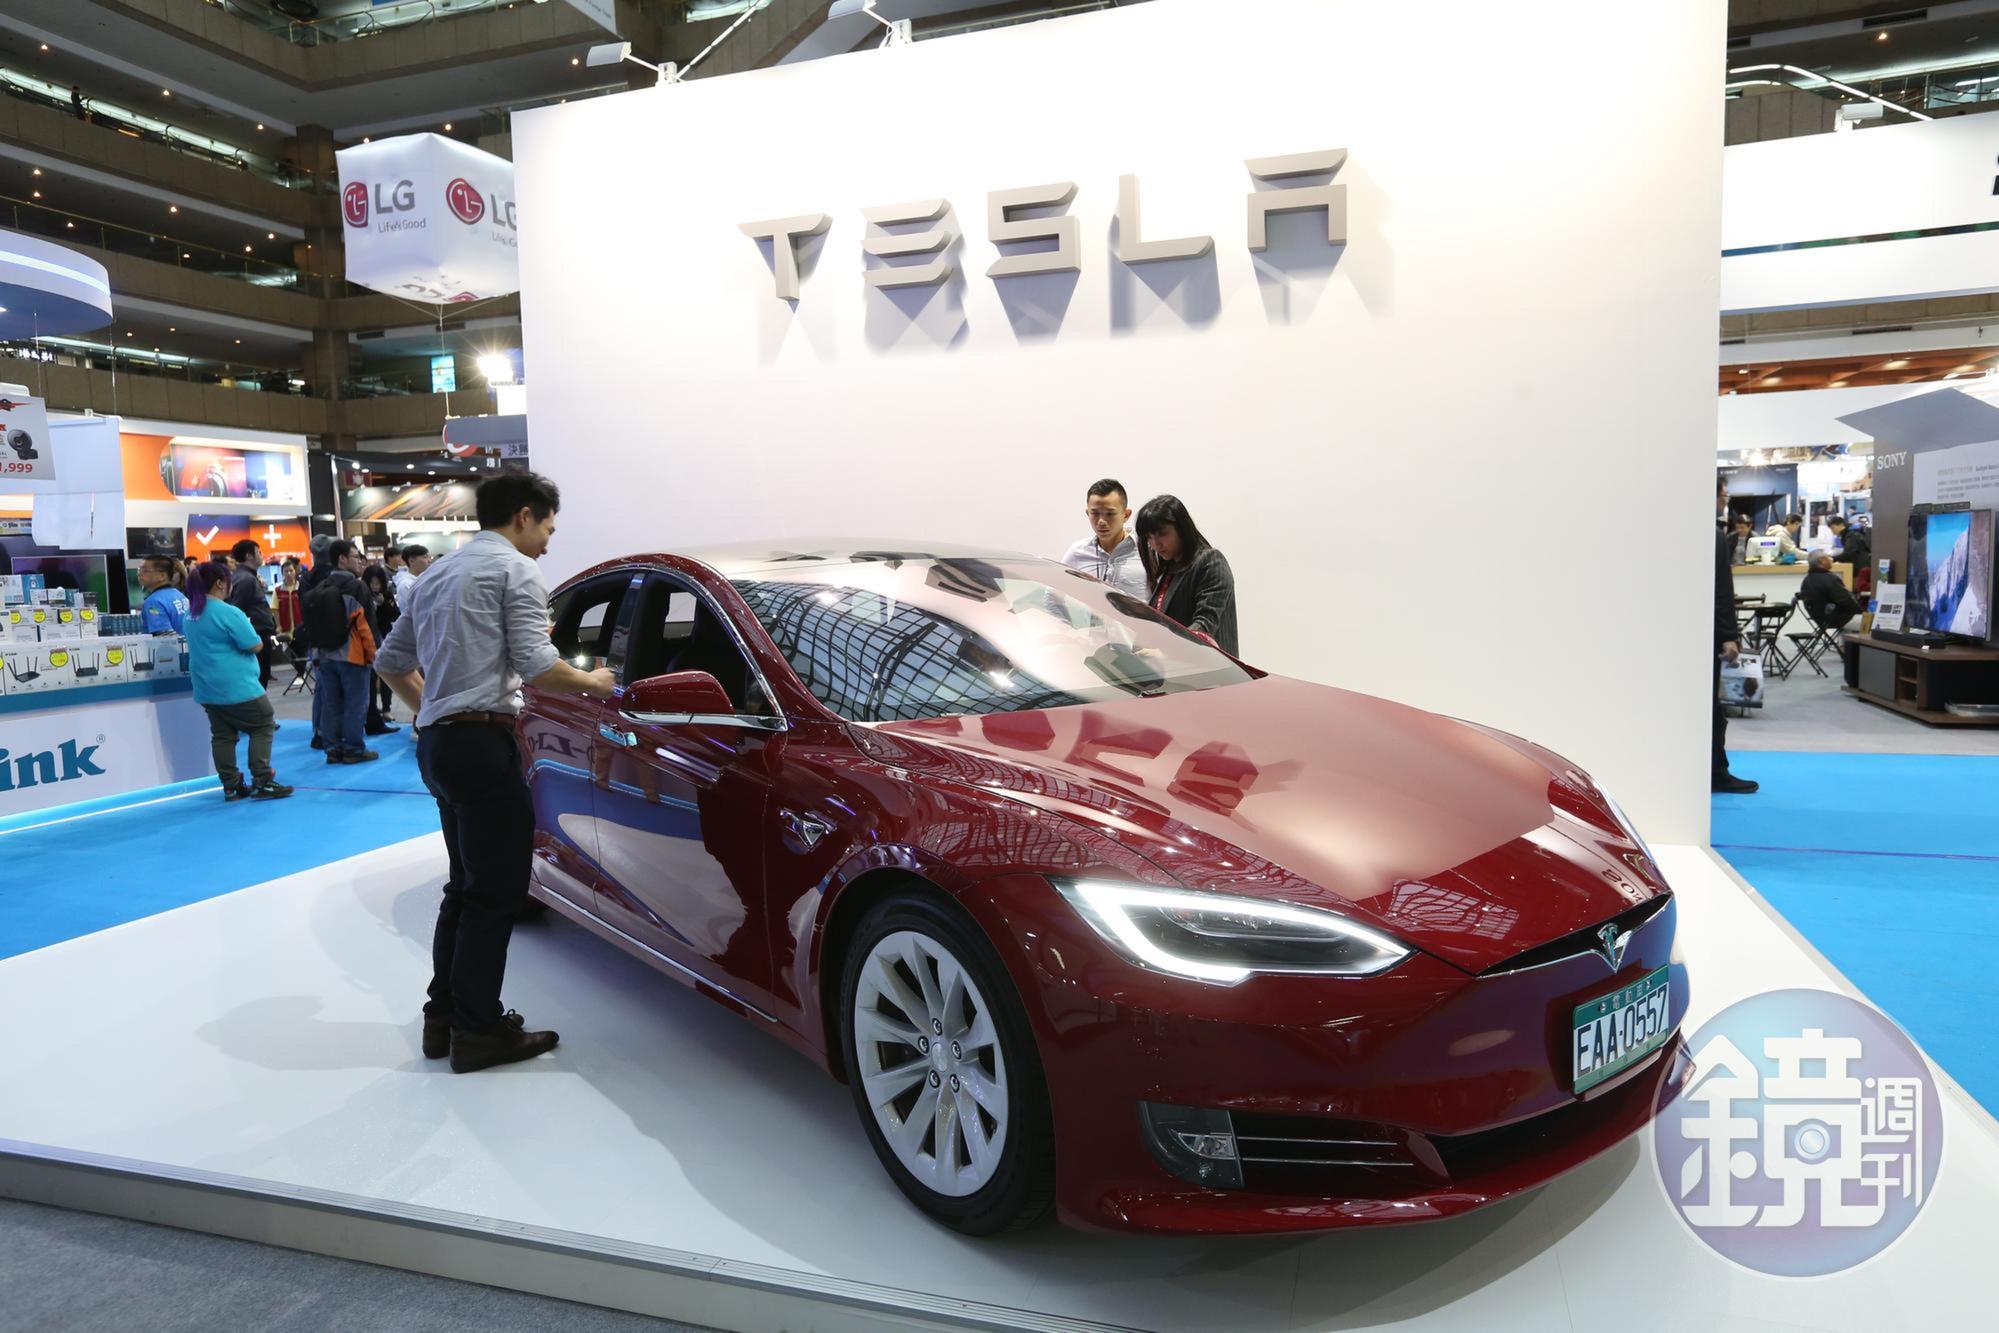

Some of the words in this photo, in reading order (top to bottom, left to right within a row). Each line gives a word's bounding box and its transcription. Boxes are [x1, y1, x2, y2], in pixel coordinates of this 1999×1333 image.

[375, 179, 415, 214] LG
[378, 221, 402, 234] Life's
[402, 218, 426, 231] Good
[737, 147, 1348, 301] TESLA
[1876, 451, 1908, 471] SONY
[1577, 983, 1668, 1078] EAA-0557
